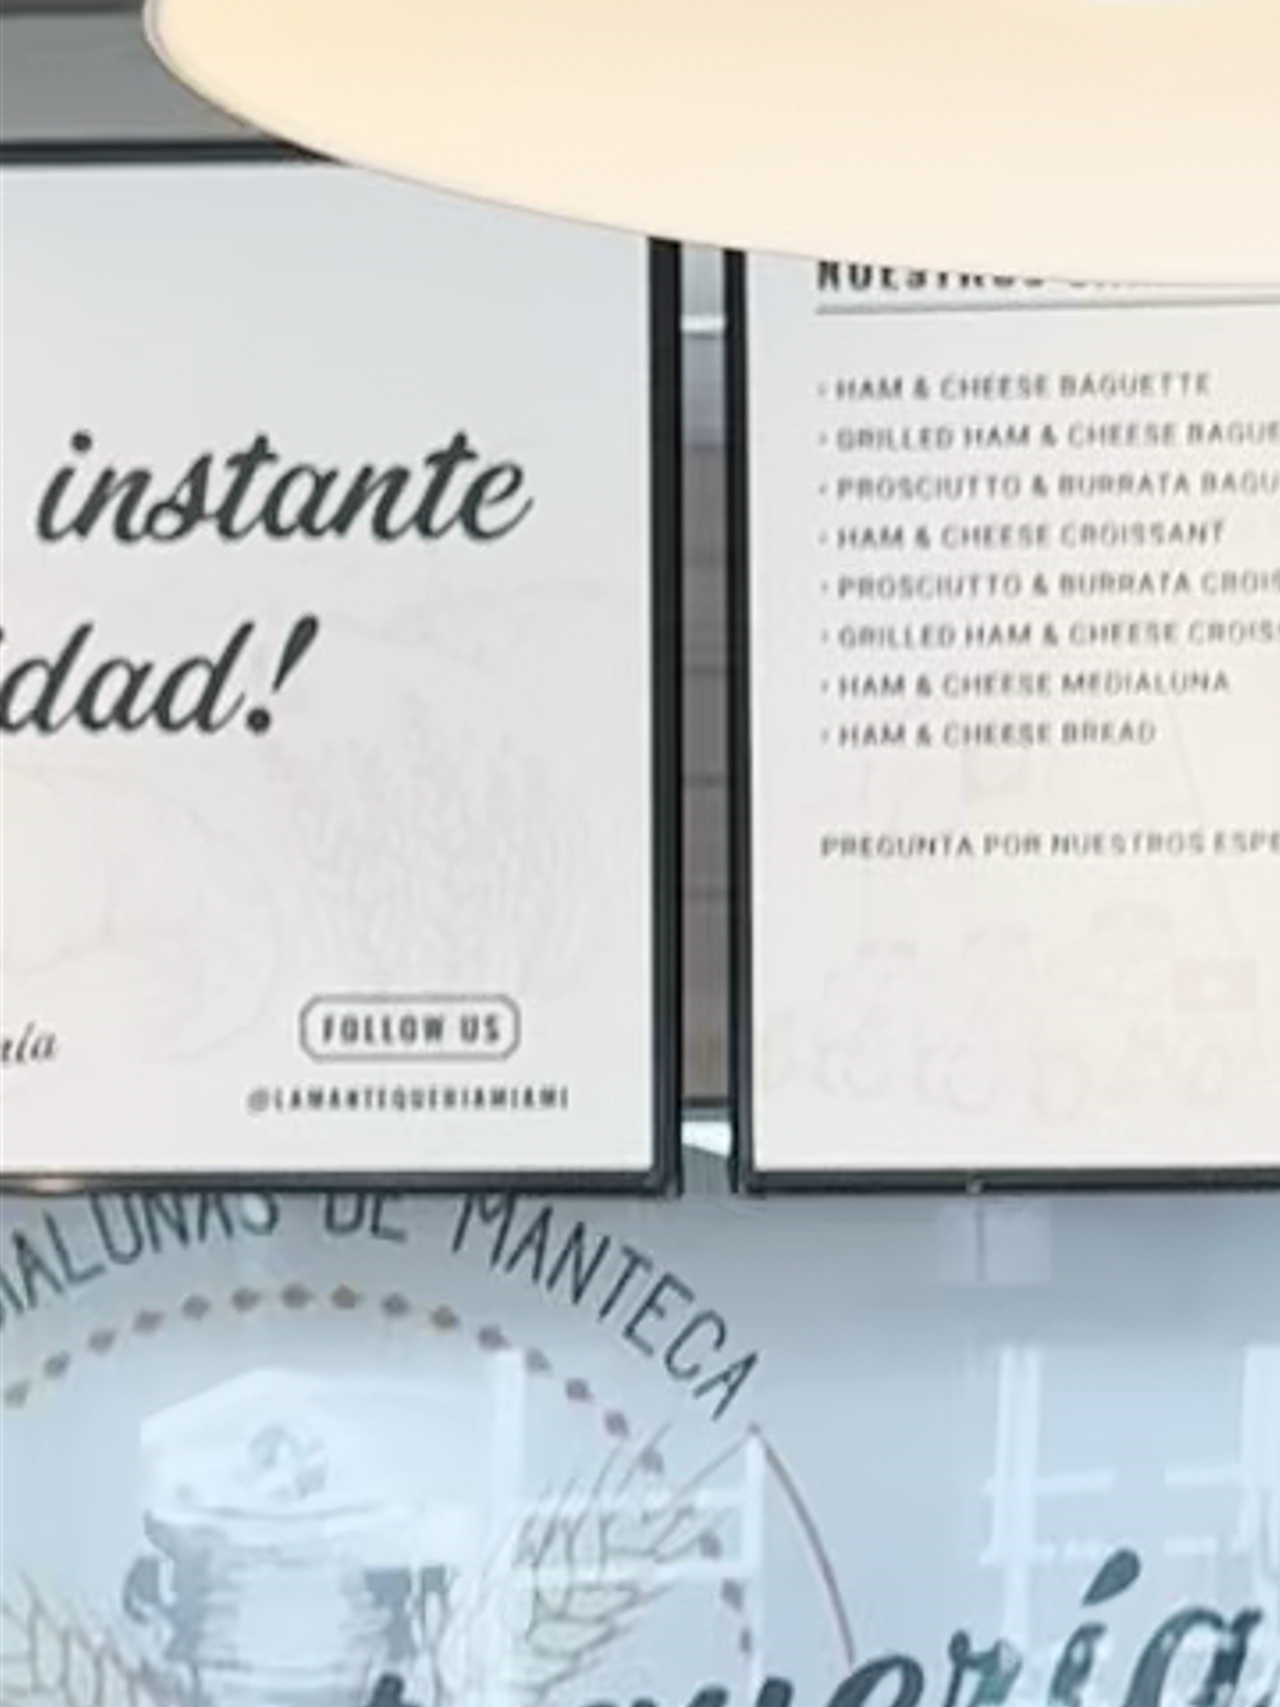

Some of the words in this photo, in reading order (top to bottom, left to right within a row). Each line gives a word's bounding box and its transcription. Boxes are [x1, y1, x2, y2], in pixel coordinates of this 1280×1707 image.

[835, 375, 904, 401] HAM
[912, 375, 931, 401] &
[939, 373, 1049, 401] CHEESE
[1058, 370, 1210, 400] BAGUETTE
[835, 424, 955, 453] GRILLED
[962, 423, 1031, 449] HAM
[1040, 423, 1058, 448] &
[1066, 421, 1176, 450] CHEESE
[36, 429, 534, 543] instante
[835, 473, 1022, 502] PROSCIUTTO
[1030, 473, 1049, 498] &
[1057, 470, 1191, 498] BURRATA
[836, 524, 905, 550] HAM
[914, 524, 932, 551] &
[940, 522, 1050, 551] CHEESE
[1059, 517, 1225, 550] CROISSANT
[836, 571, 1023, 601] PROSCIUTTO
[1031, 571, 1050, 597] &
[1058, 569, 1191, 598] BURRATA
[836, 622, 957, 651] GRILLED
[964, 622, 1032, 649] HAM
[1042, 621, 1060, 648] &
[1068, 620, 1178, 647] CHEESE
[0, 613, 320, 736] dad!
[838, 673, 906, 699] HAM
[915, 673, 933, 699] &
[940, 670, 1052, 699] CHEESE
[1060, 669, 1230, 696] MEDIALUNA
[838, 722, 907, 748] HAM
[915, 722, 933, 748] &
[942, 721, 1052, 749] CHEESE
[1060, 719, 1157, 746] BREAD
[819, 832, 975, 860] PREGUNTA
[982, 832, 1042, 857] POR
[1050, 830, 1206, 857] NUESTROS
[322, 1013, 446, 1046] FOLLOW
[459, 1012, 501, 1045] US
[450, 1191, 762, 1424] MANTECA
